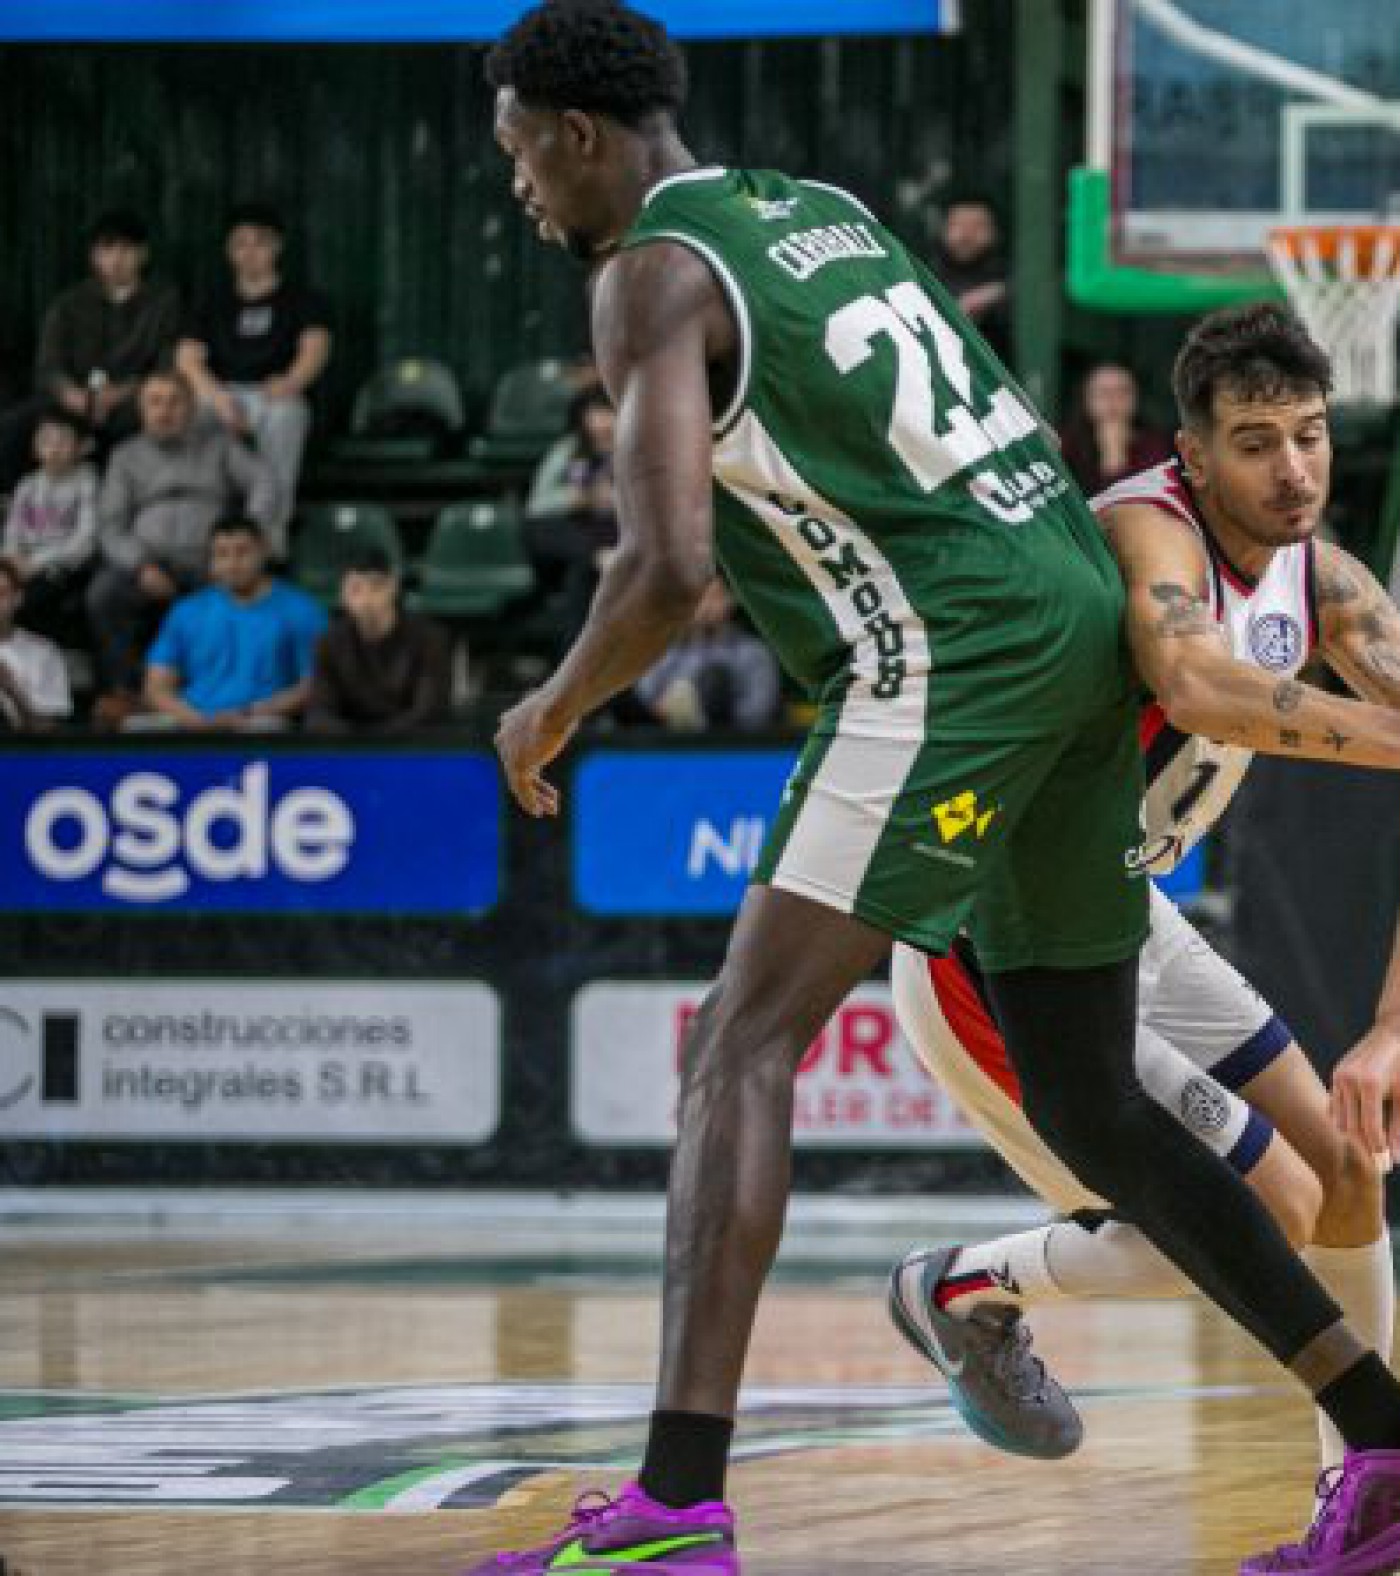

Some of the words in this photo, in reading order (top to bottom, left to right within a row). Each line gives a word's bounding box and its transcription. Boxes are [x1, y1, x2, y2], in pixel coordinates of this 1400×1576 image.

[824, 281, 1040, 492] 22
[24, 760, 355, 890] osde
[102, 1013, 412, 1048] construcciones
[102, 1060, 304, 1110] integrales
